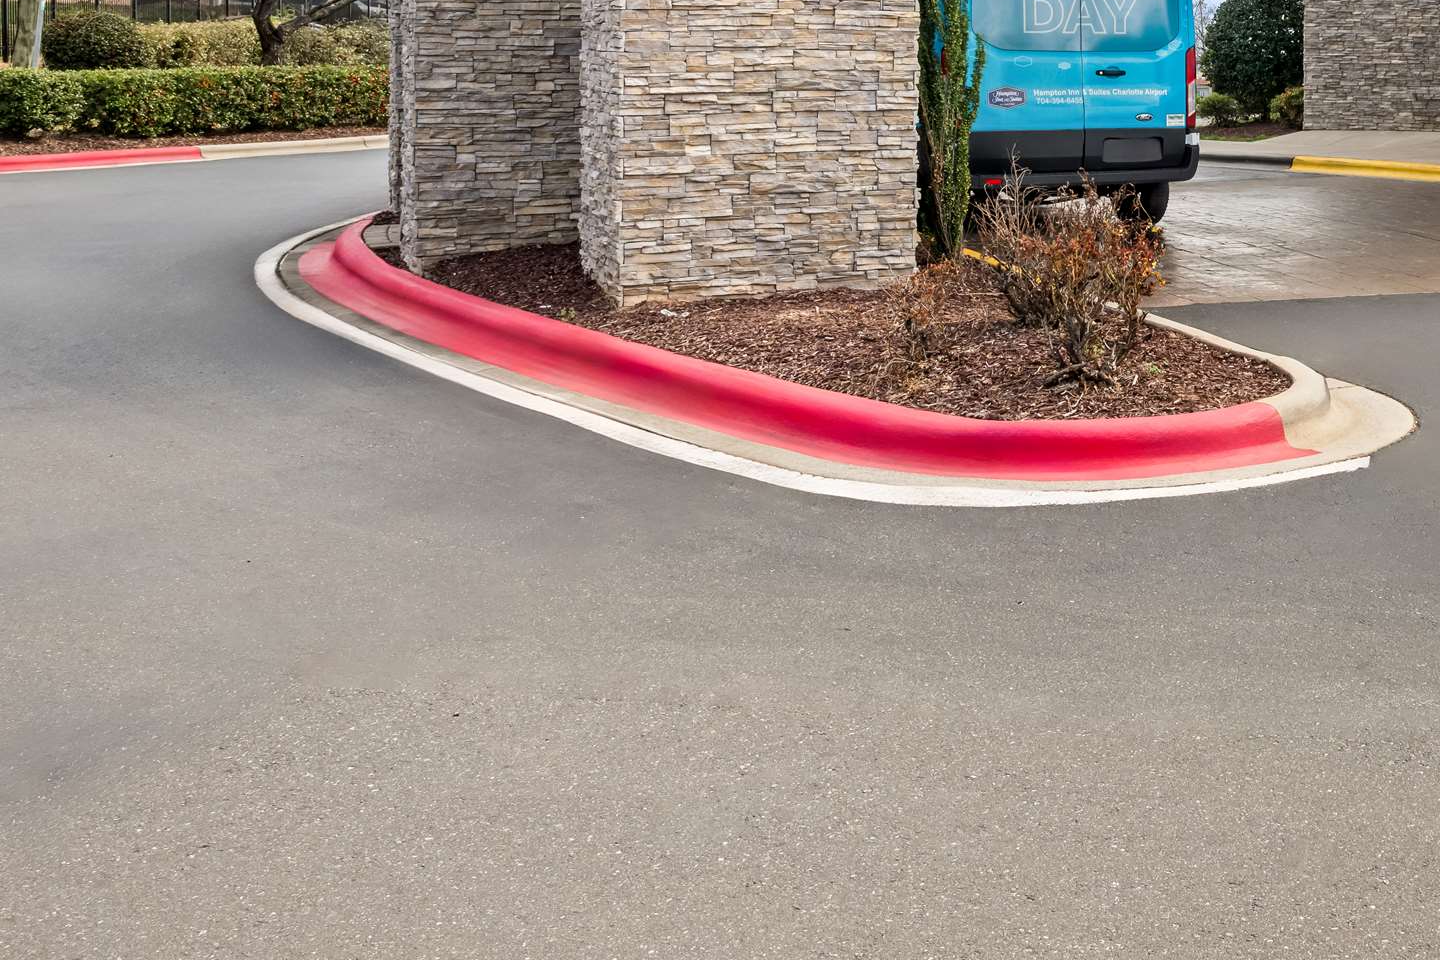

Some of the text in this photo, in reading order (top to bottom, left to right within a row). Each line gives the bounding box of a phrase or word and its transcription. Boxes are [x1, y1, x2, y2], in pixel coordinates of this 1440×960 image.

[1033, 88, 1067, 97] Hampton
[1068, 88, 1080, 96] Inn
[1144, 88, 1168, 97] Airport
